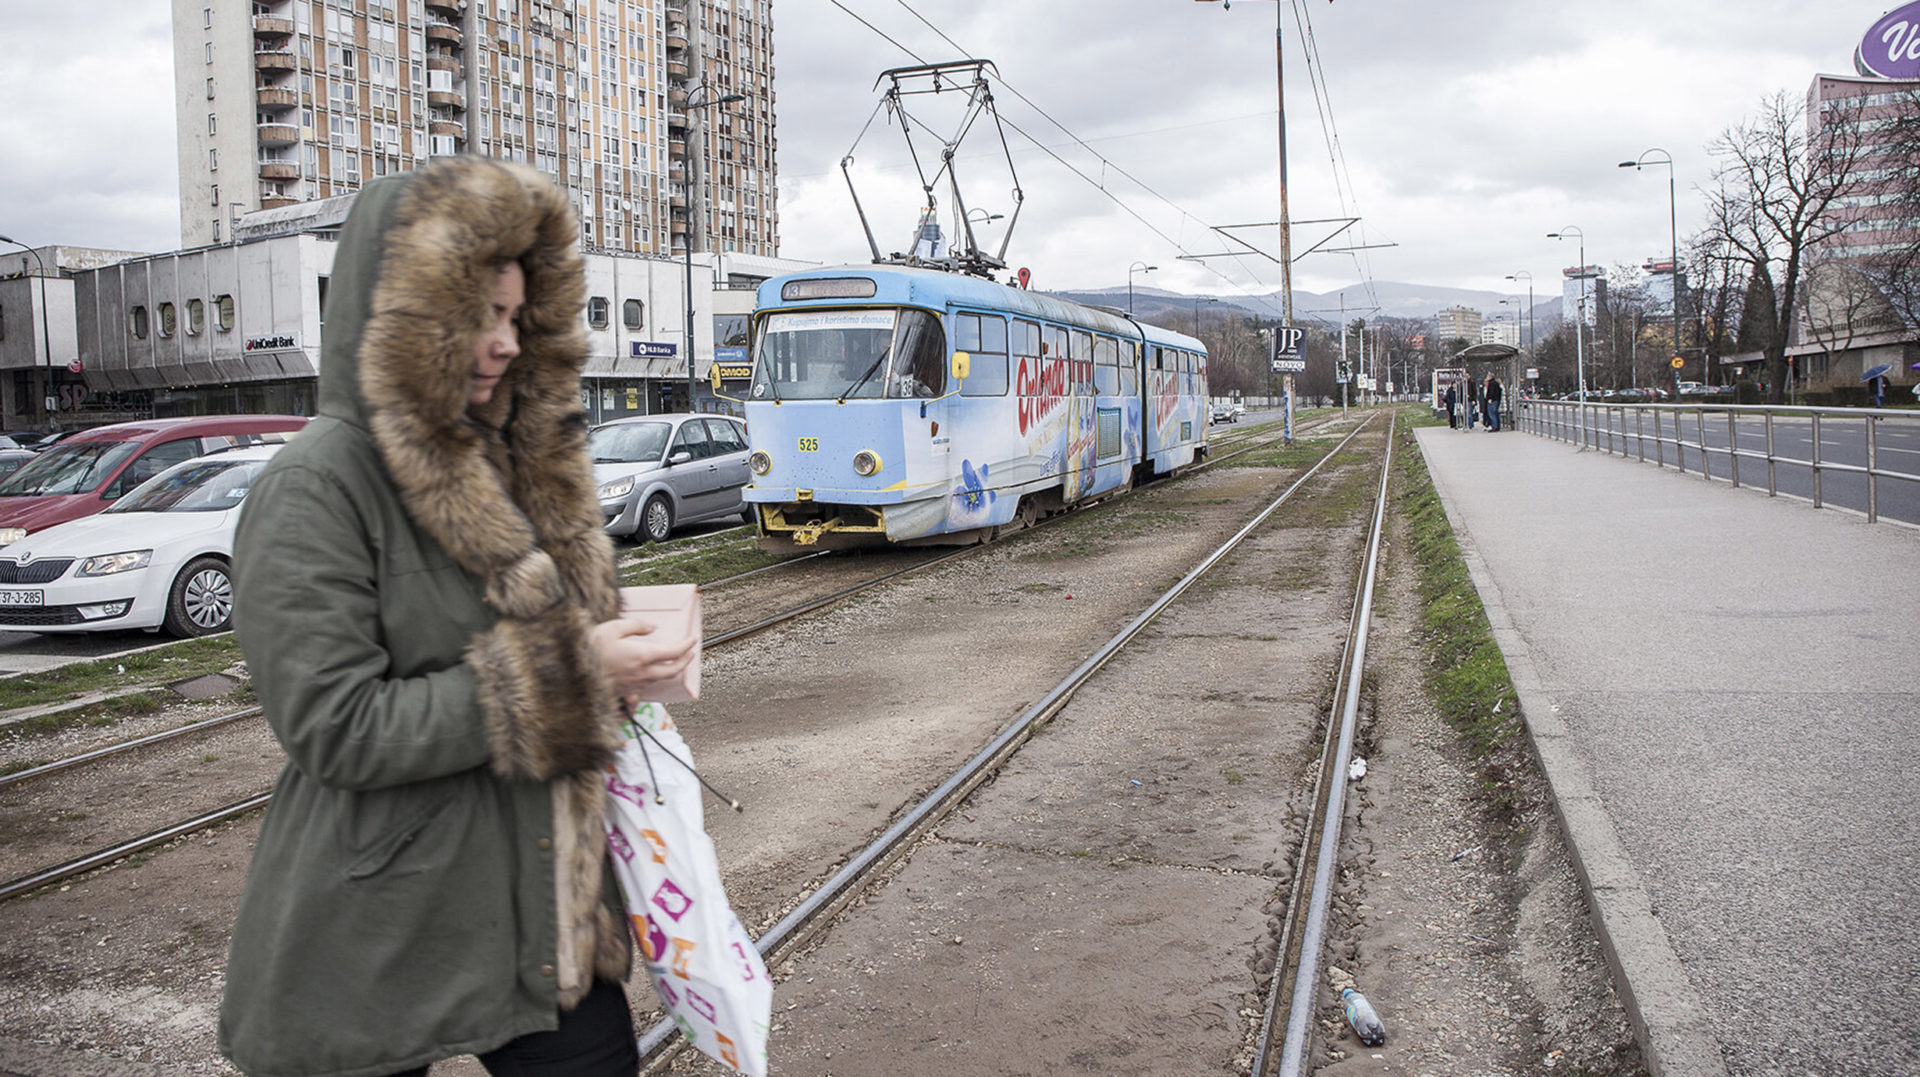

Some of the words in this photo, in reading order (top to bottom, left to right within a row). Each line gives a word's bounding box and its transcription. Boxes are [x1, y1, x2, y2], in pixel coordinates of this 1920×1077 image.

[252, 337, 278, 349] UniCredit
[279, 336, 296, 347] Bank
[1278, 328, 1302, 354] JP
[1016, 342, 1066, 437] Orlando
[799, 438, 818, 451] 525
